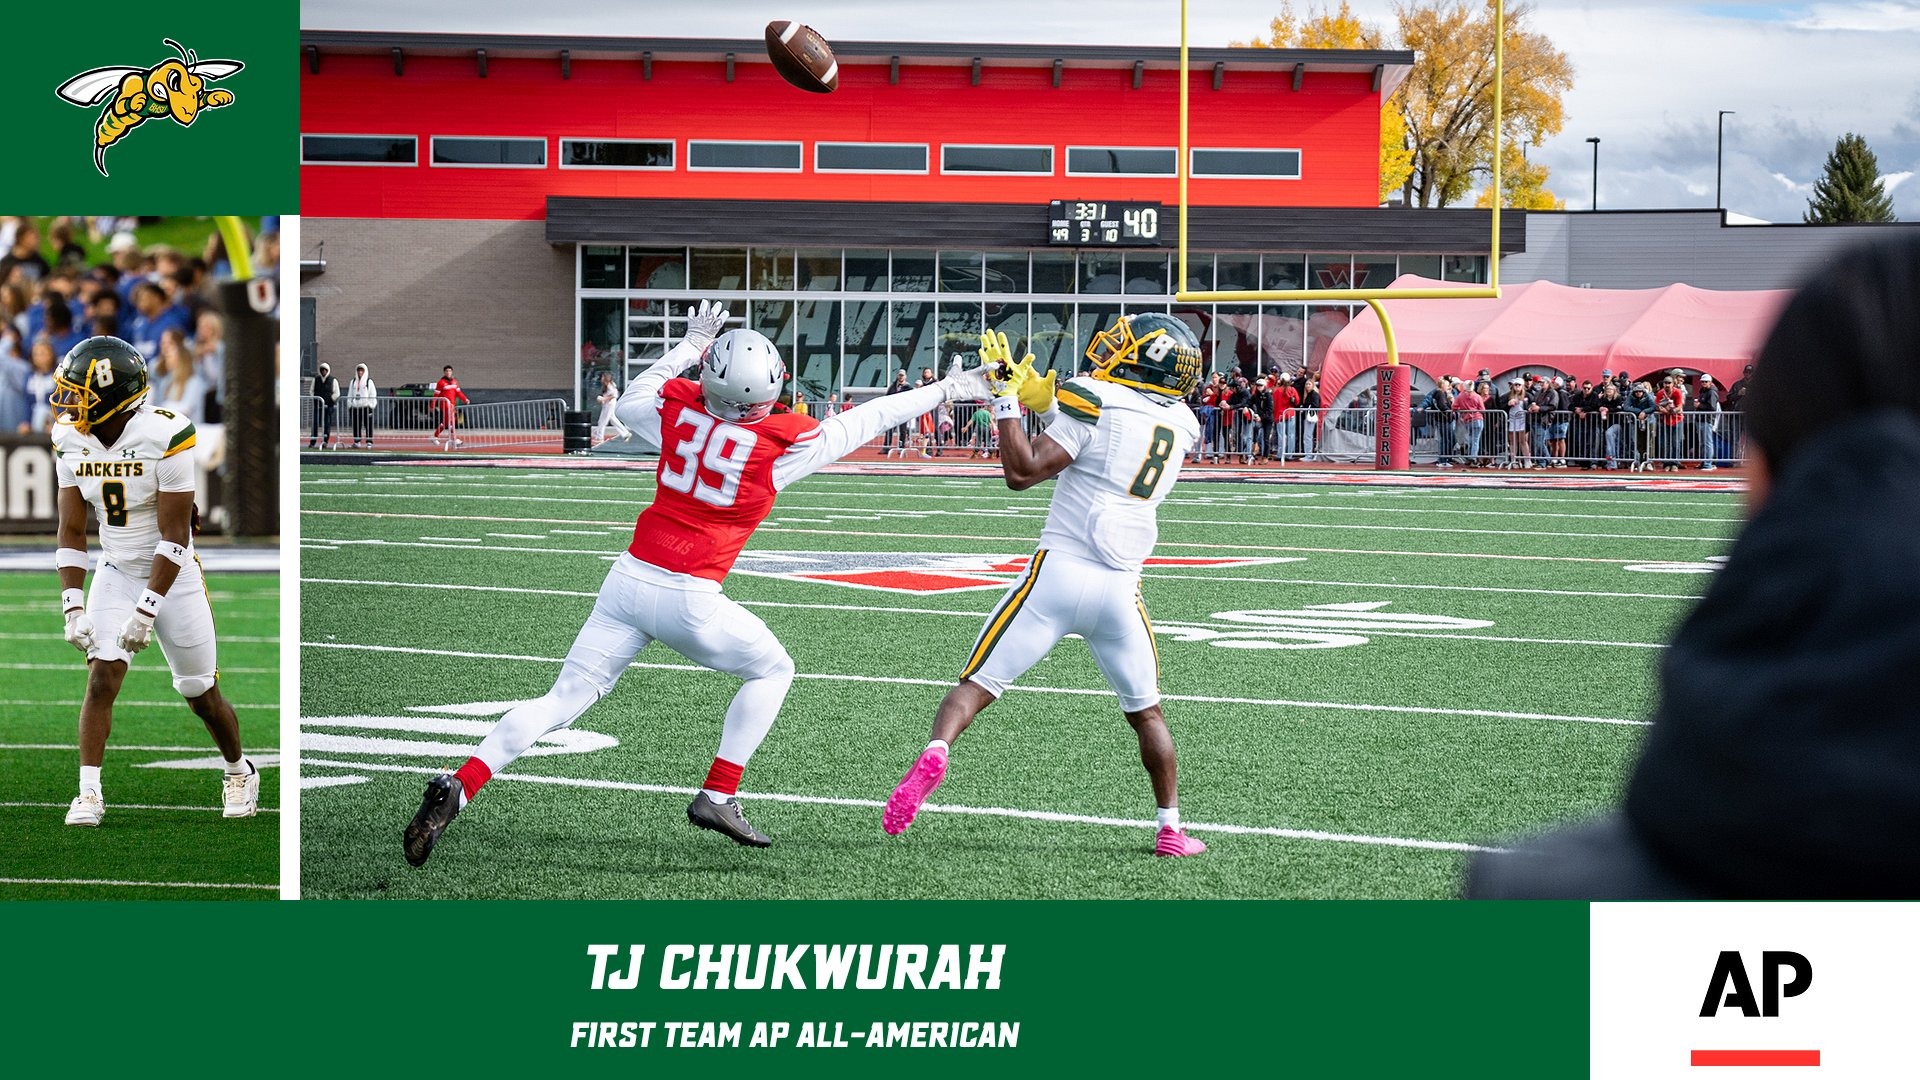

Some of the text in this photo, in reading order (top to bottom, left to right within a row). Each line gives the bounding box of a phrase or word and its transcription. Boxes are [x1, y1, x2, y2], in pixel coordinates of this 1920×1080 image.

[1075, 203, 1106, 220] 3:31
[1100, 220, 1119, 228] GUEST
[1123, 208, 1157, 238] 40
[1052, 228, 1069, 241] 49
[1081, 228, 1090, 242] 3
[1106, 228, 1118, 242] 10
[1144, 333, 1177, 362] 8
[95, 358, 114, 388] 8
[1380, 370, 1395, 467] WESTERN
[75, 461, 144, 478] JACKETS
[660, 406, 758, 507] 39
[1127, 424, 1175, 500] 8
[101, 479, 128, 528] 8
